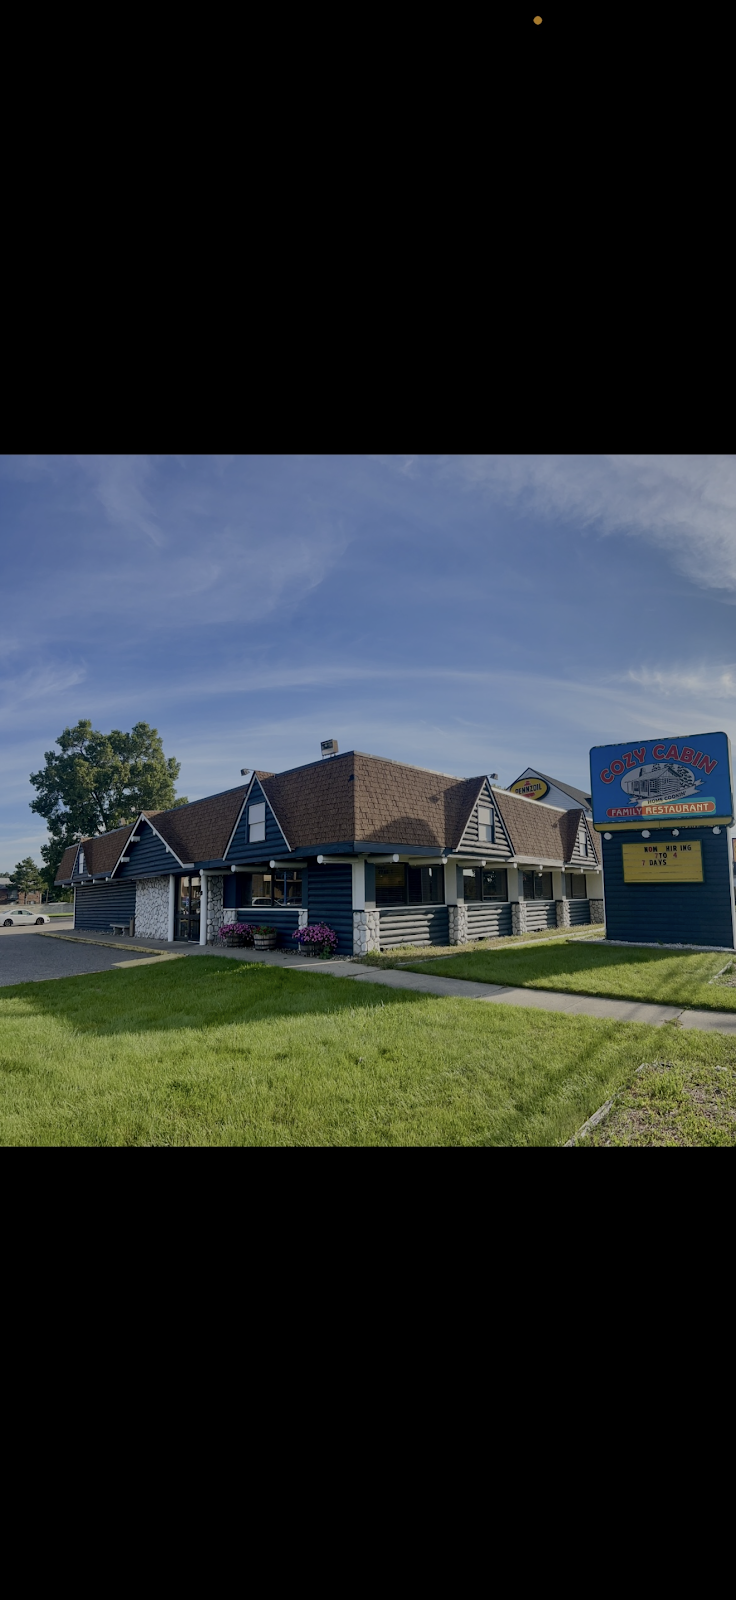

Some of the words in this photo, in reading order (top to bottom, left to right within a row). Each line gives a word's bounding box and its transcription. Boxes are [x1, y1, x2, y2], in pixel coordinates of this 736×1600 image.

[600, 747, 646, 784] COZY
[652, 744, 717, 775] CABIN
[515, 783, 542, 794] PENNZOIL
[611, 807, 642, 817] FAMILY
[645, 803, 709, 815] RESTAURANT
